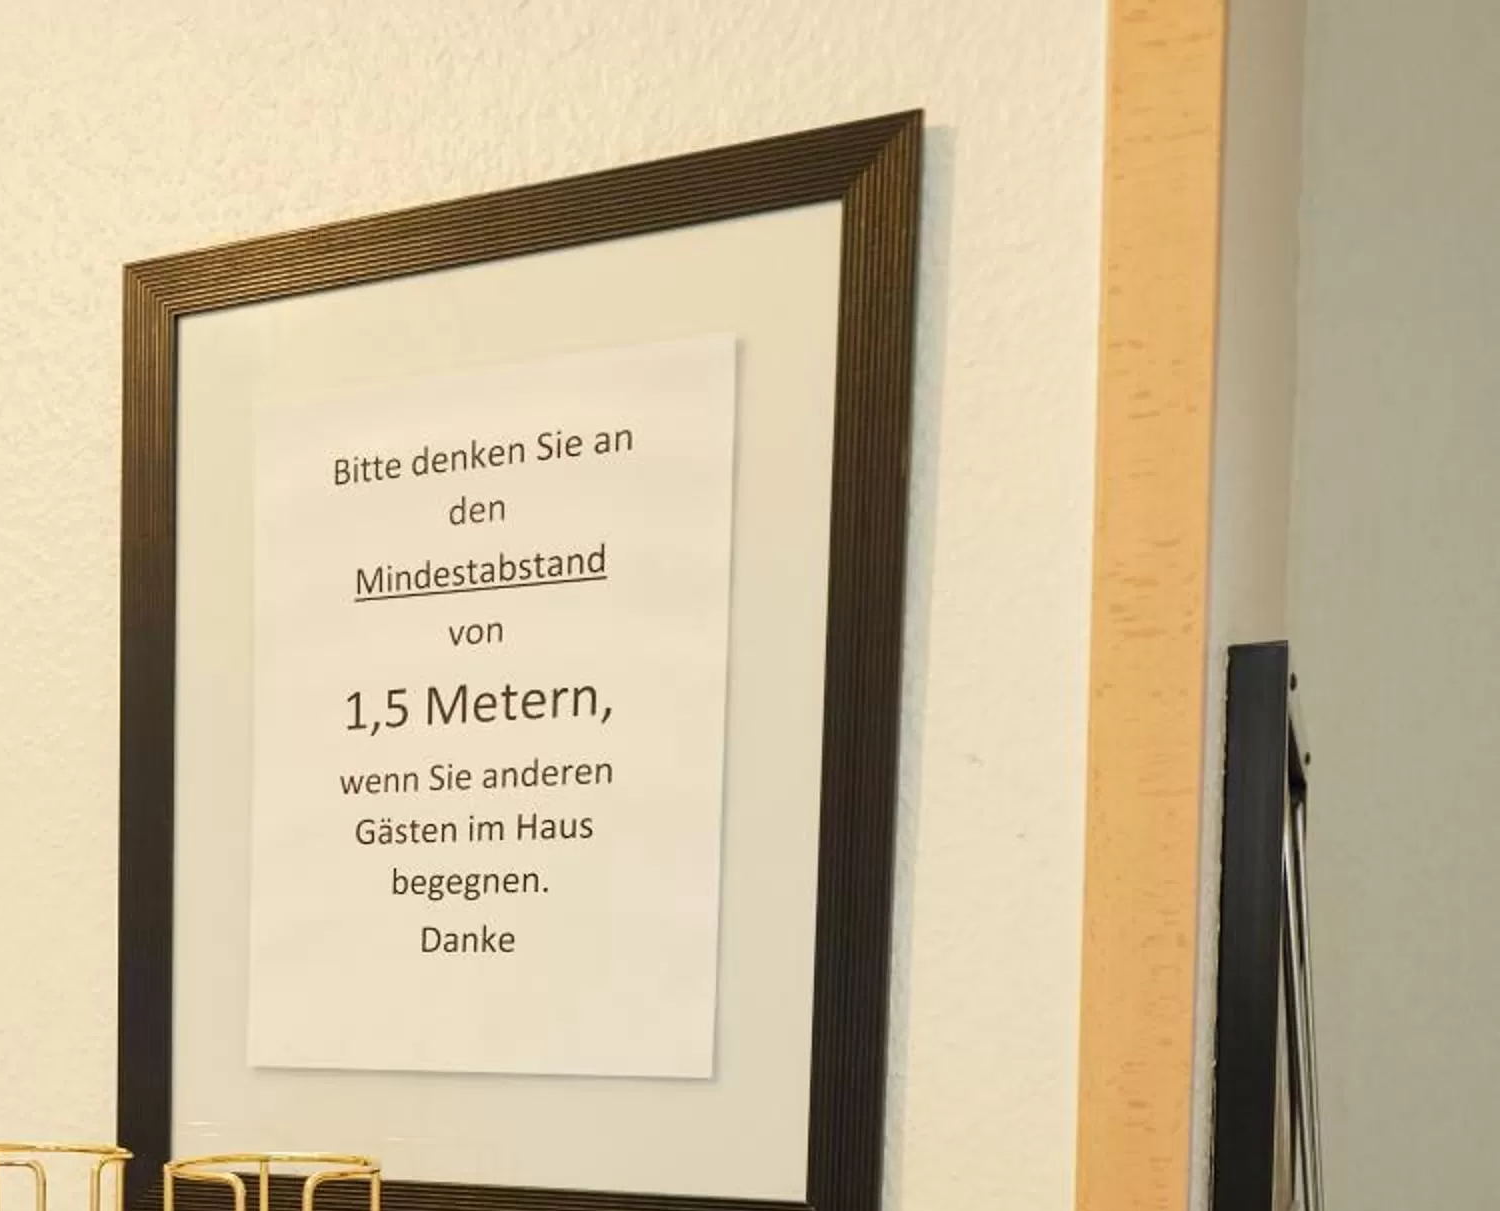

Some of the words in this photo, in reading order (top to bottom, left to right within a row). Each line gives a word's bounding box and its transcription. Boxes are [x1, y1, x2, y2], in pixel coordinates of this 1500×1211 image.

[334, 456, 402, 486] Bitte
[412, 440, 525, 476] denken
[537, 430, 583, 461] Sie
[594, 428, 634, 454] an
[448, 496, 506, 526] den
[355, 543, 607, 599] Mindestabstand
[448, 622, 504, 647] von
[345, 688, 410, 736] 1,5
[426, 683, 613, 726] Metern,
[340, 770, 419, 796] wenn
[428, 763, 472, 792] Sie
[482, 758, 614, 790] anderen
[355, 818, 458, 846] Gästen
[468, 815, 505, 842] im
[517, 812, 594, 841] Haus
[392, 867, 550, 901] begegnen.
[421, 924, 516, 954] Danke
